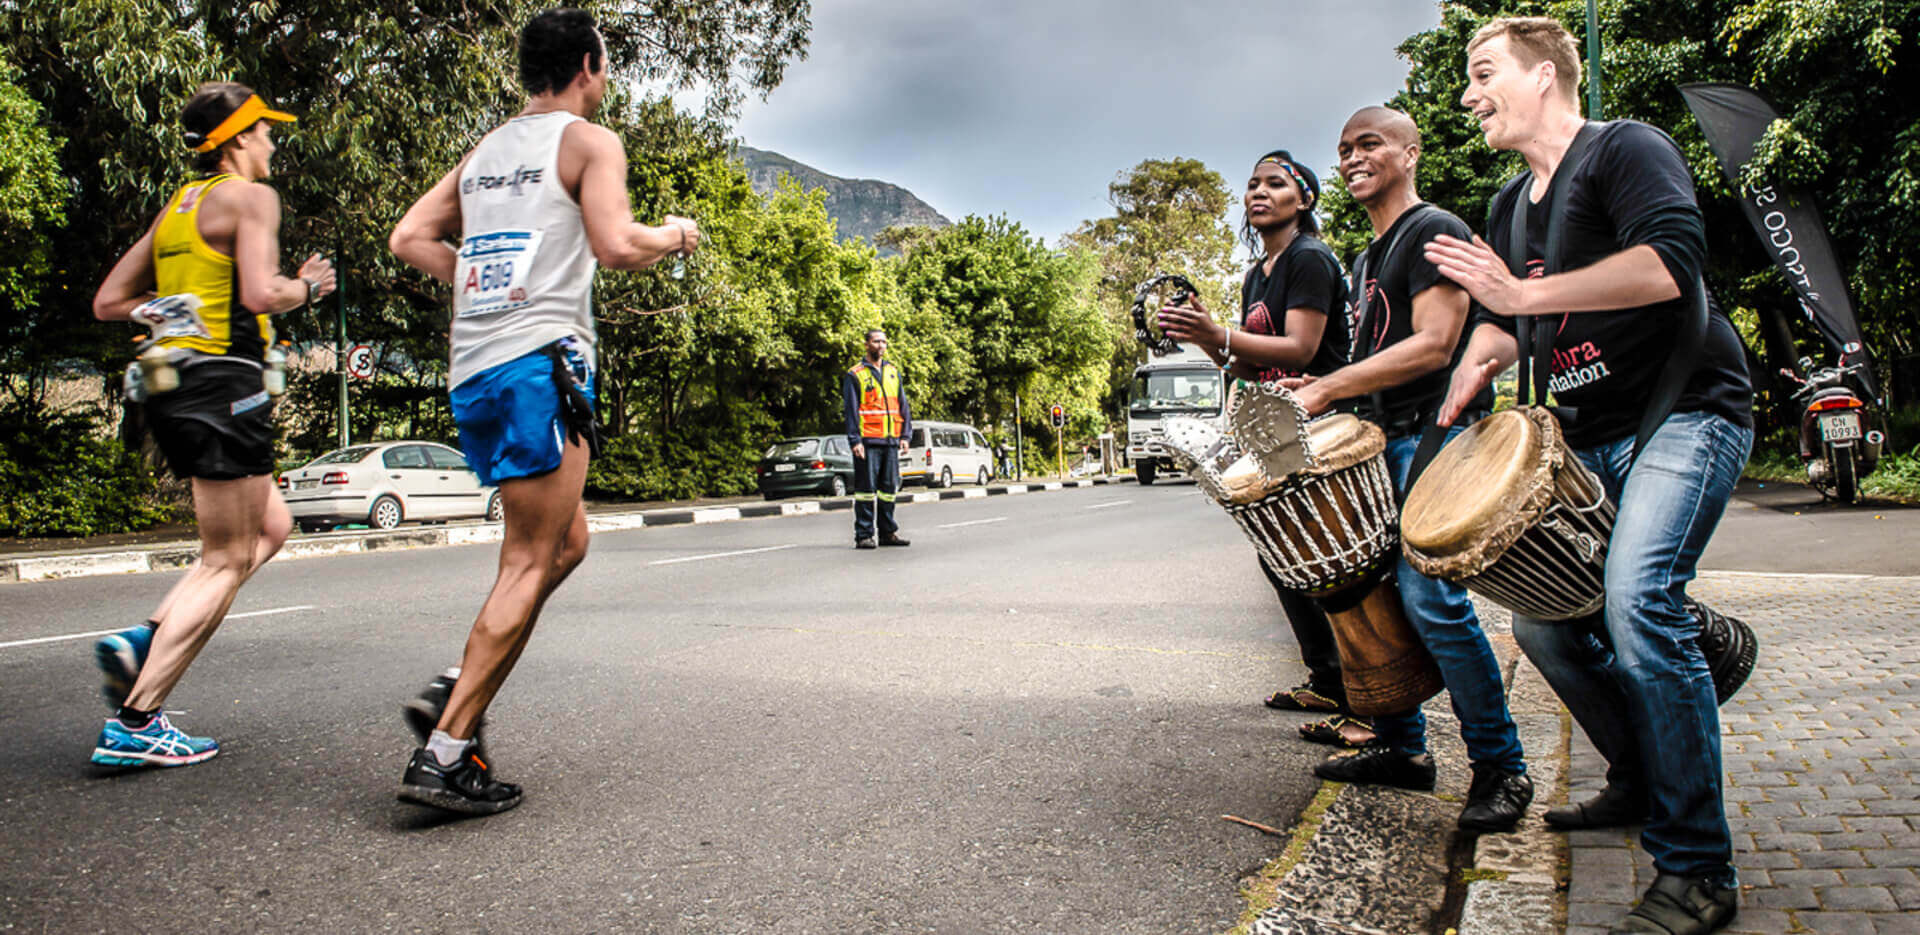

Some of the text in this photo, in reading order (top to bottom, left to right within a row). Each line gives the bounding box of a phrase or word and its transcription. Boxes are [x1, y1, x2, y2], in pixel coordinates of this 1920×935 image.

[1551, 341, 1602, 374] ebra
[1548, 360, 1611, 393] dation
[1831, 416, 1847, 428] CN
